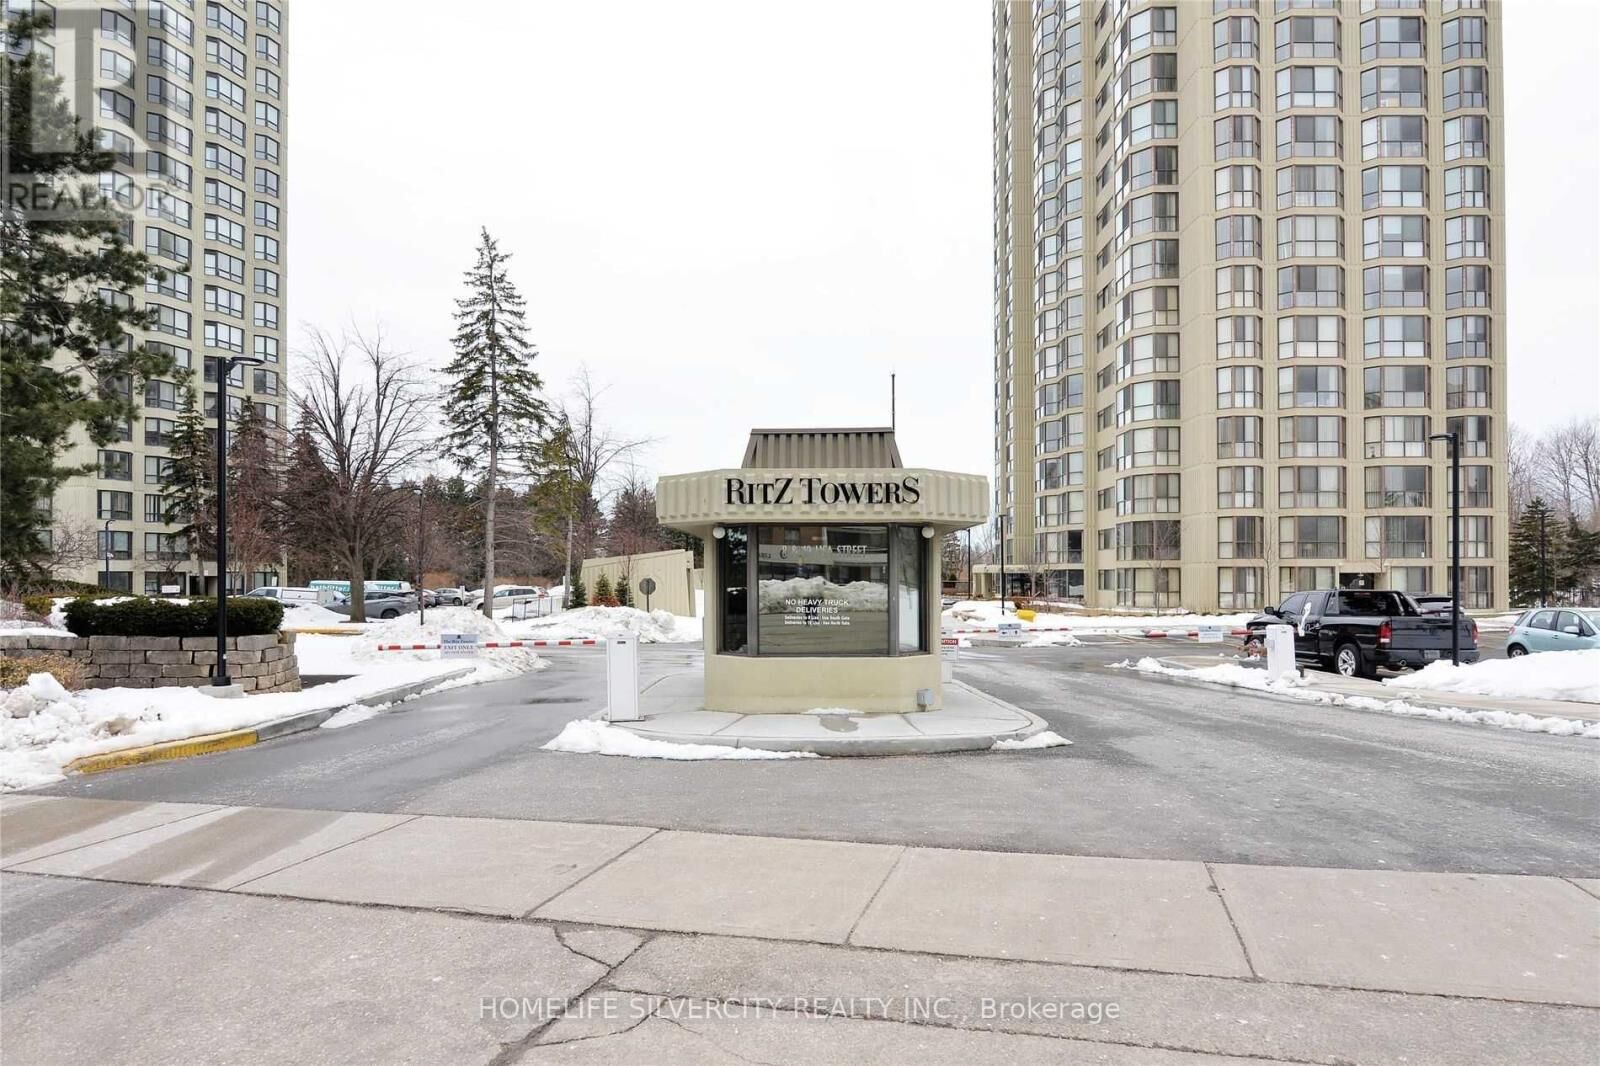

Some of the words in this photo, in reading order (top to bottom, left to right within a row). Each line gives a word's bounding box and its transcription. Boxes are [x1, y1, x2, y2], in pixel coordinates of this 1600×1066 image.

[725, 477, 793, 505] RITZ
[799, 476, 920, 505] TOWERS
[836, 545, 868, 553] STREET
[795, 606, 839, 614] DELIVERIES
